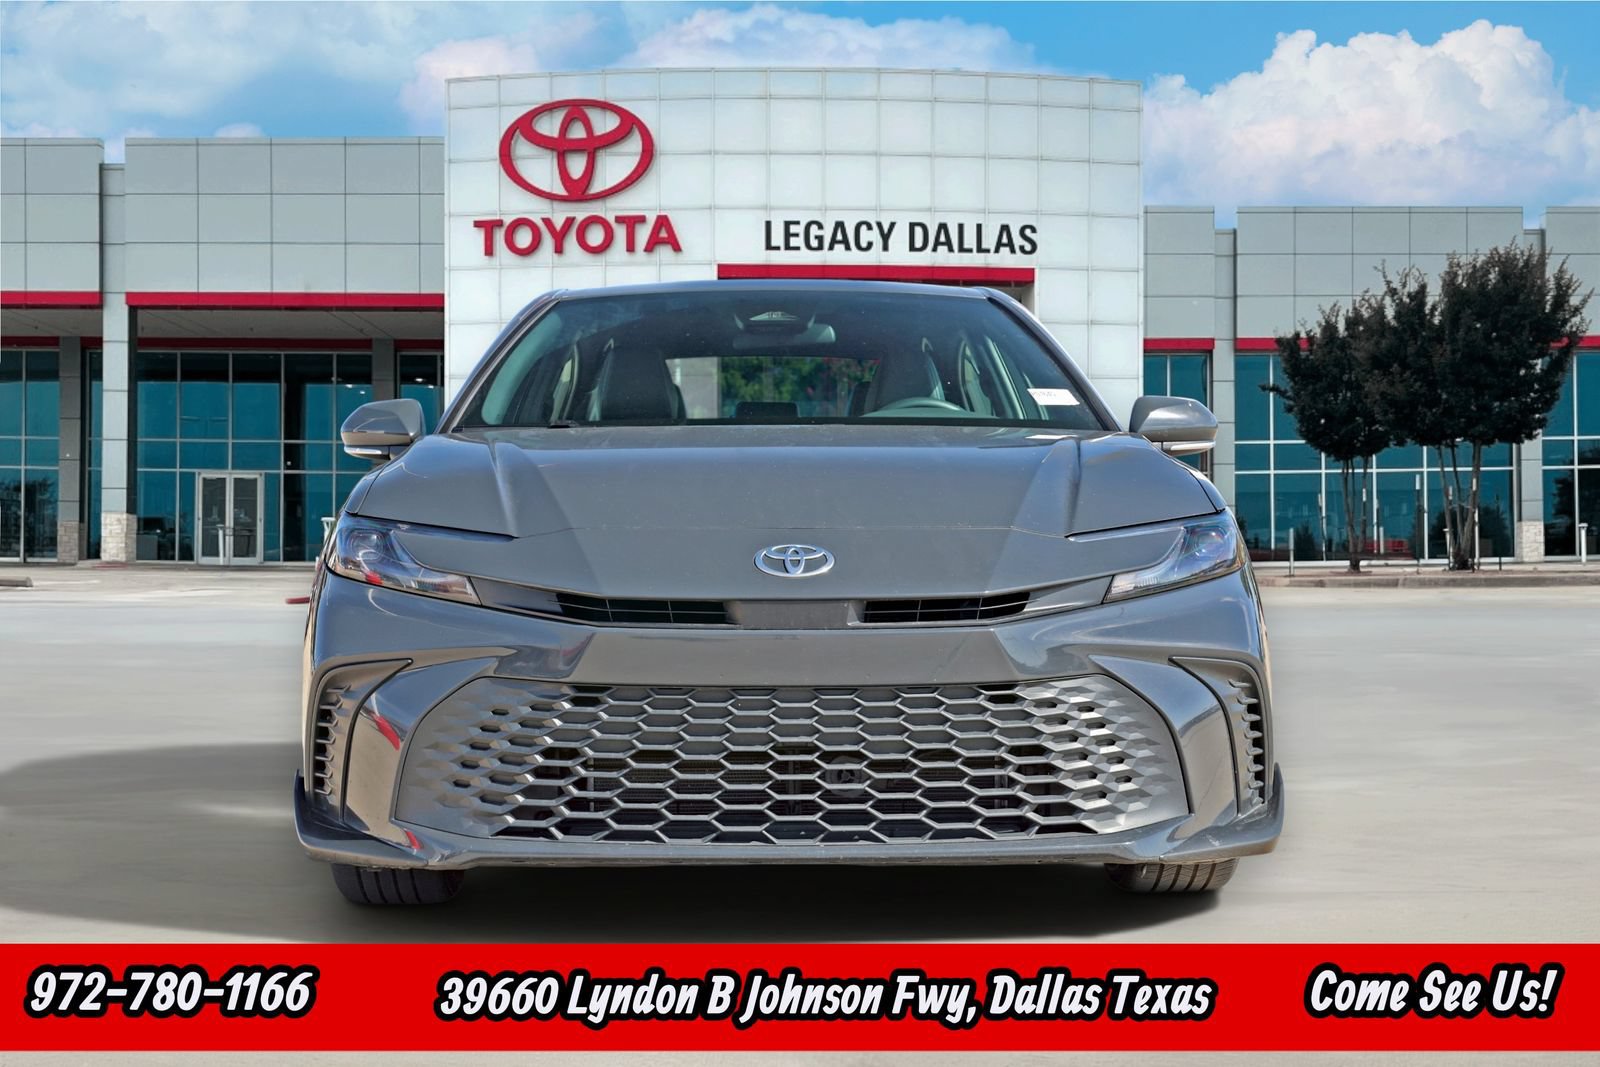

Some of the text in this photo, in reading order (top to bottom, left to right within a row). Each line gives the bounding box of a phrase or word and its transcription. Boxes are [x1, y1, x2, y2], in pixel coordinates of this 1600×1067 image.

[474, 213, 682, 257] TOYOTA
[765, 220, 1038, 255] LEGACY DALLAS
